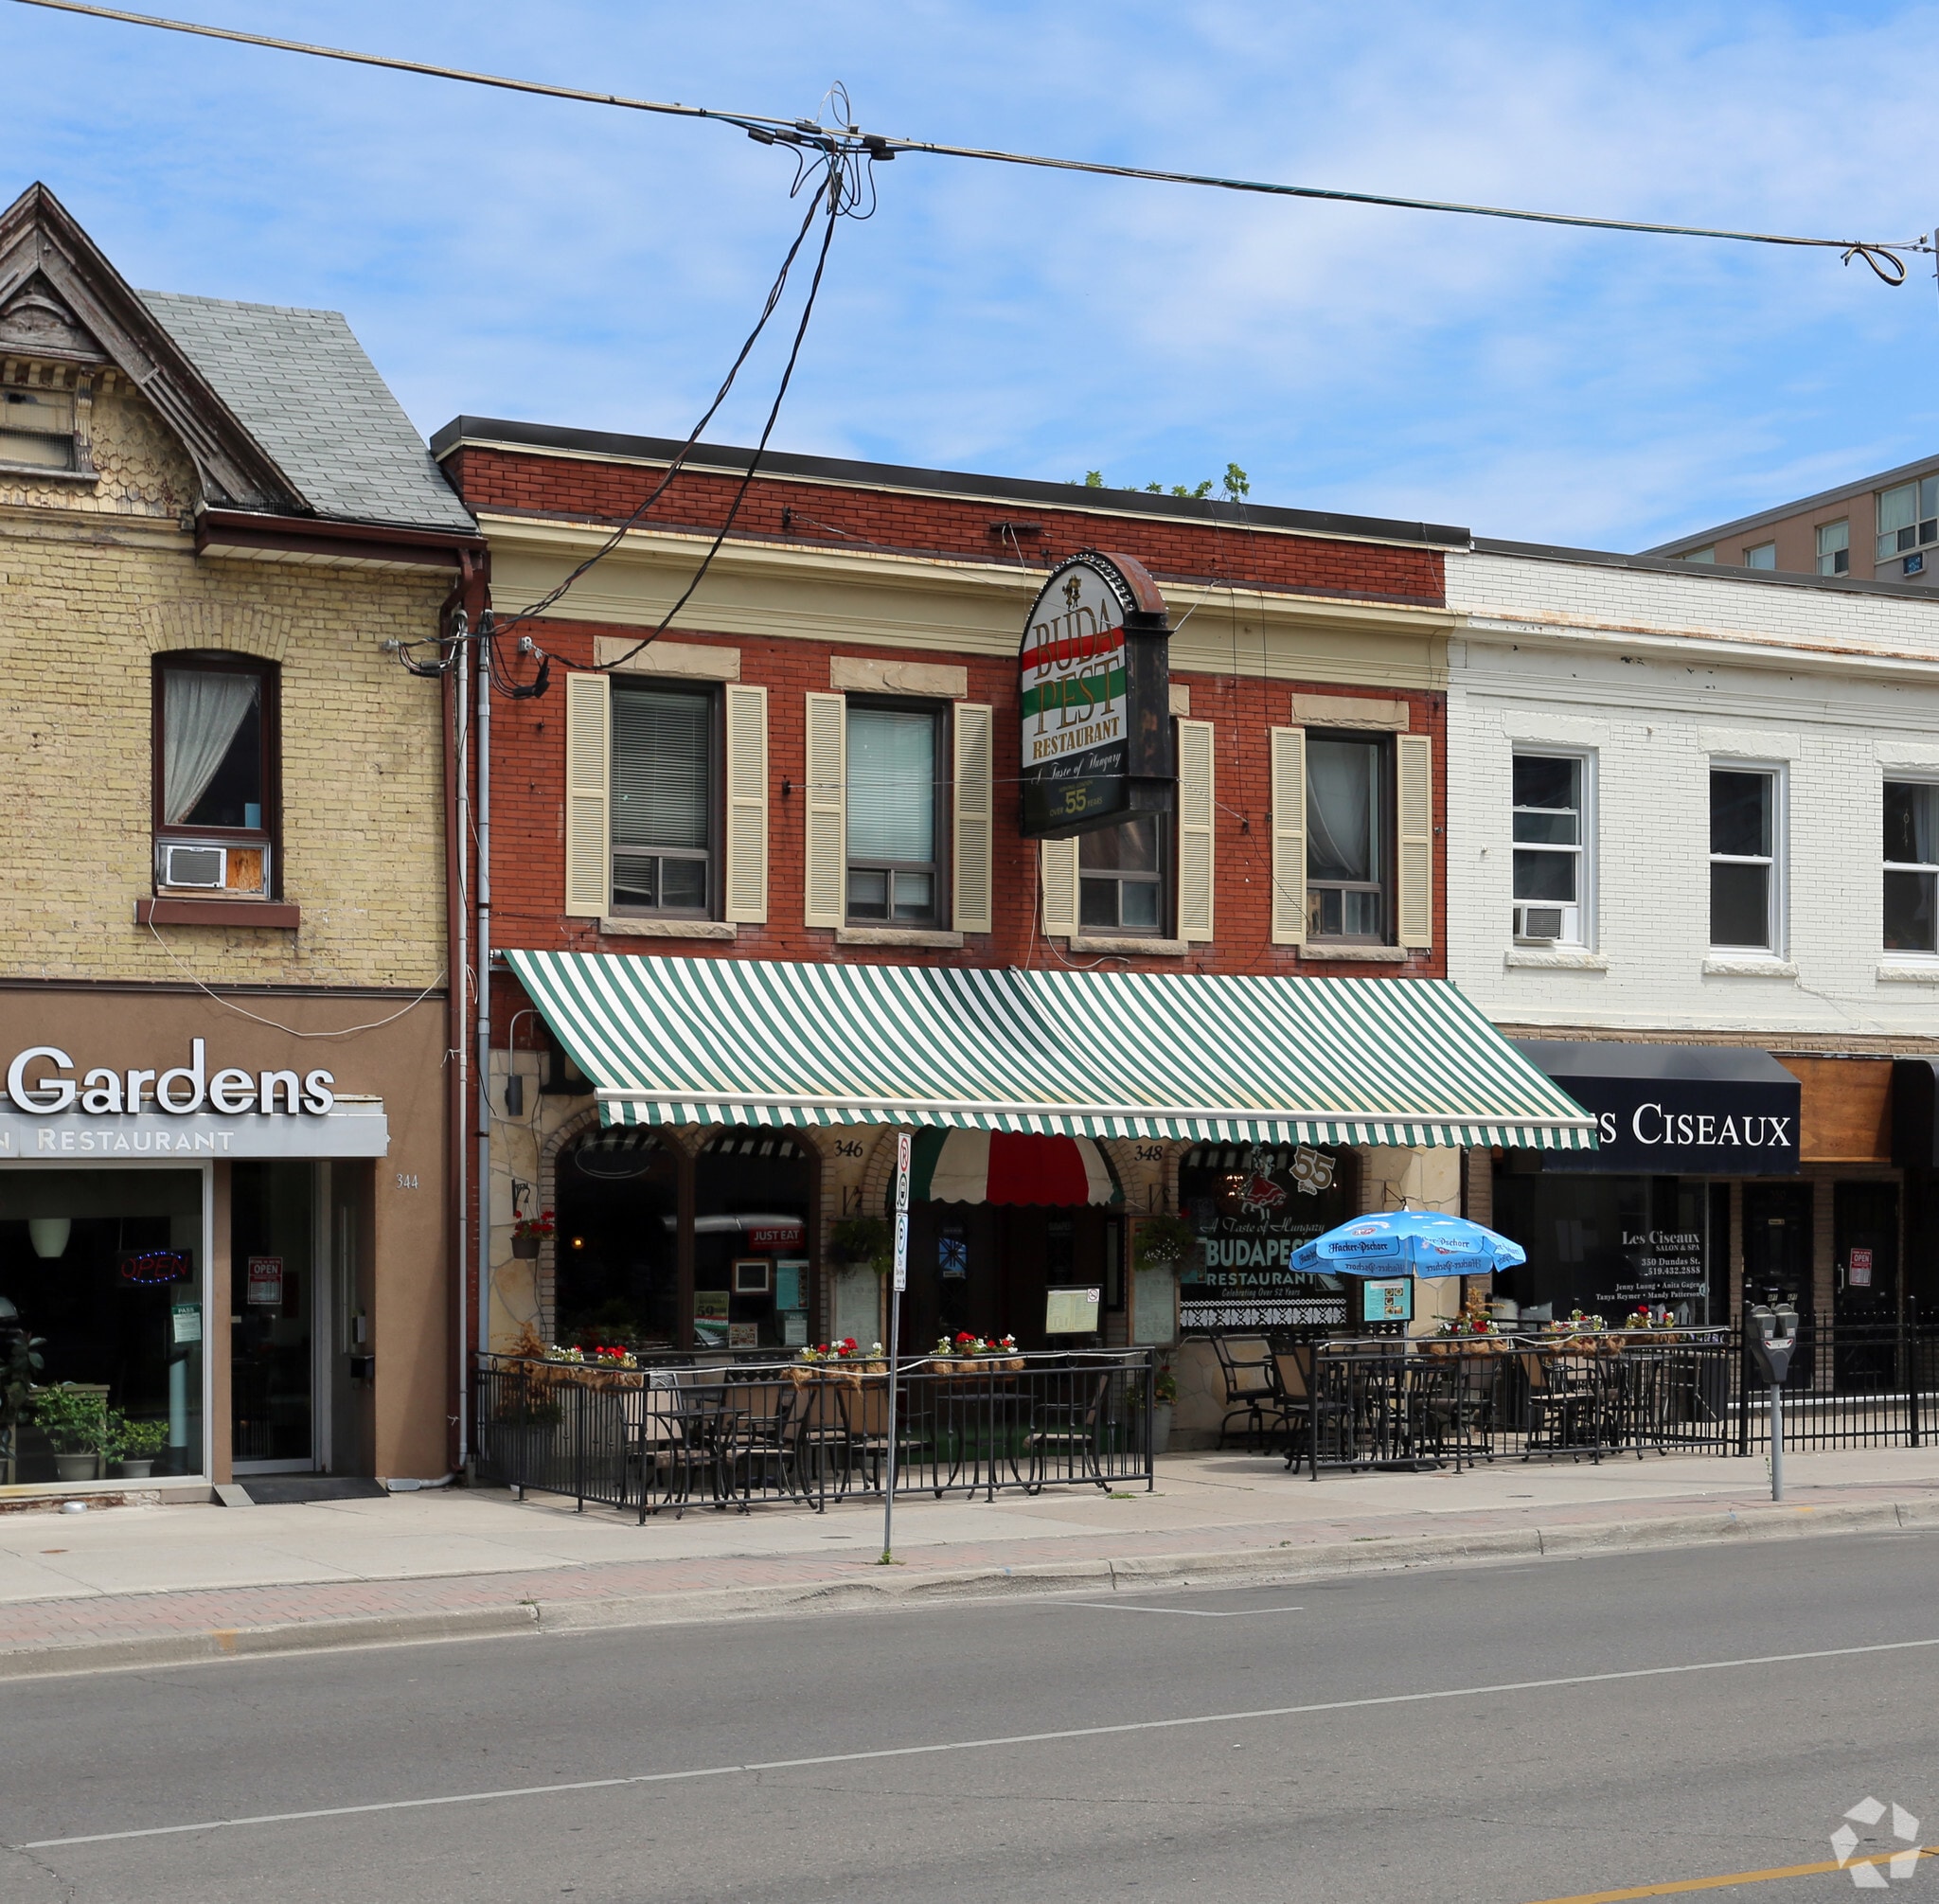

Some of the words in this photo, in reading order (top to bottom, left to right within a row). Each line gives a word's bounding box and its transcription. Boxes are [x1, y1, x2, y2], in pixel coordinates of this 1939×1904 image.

[1032, 598, 1118, 680] BUDA
[1033, 655, 1120, 737] PEST
[1033, 716, 1120, 760] RESTAURANT
[1051, 761, 1072, 780] Taste
[1074, 757, 1084, 779] of
[1089, 752, 1121, 773] Hungary
[1049, 807, 1063, 817] OVER
[1065, 788, 1087, 813] 55
[1087, 796, 1103, 807] YEARS
[8, 1038, 335, 1114] Gardens
[1593, 1112, 1617, 1144] S
[1632, 1103, 1791, 1147] CISEAUX
[38, 1128, 235, 1151] RESTAURANT
[834, 1139, 863, 1158] 346
[1134, 1145, 1164, 1161] 348
[1290, 1147, 1335, 1188] 55
[396, 1173, 418, 1190] 344
[754, 1231, 778, 1241] JUST
[780, 1230, 799, 1240] EAT
[1200, 1218, 1219, 1233] A
[1222, 1217, 1255, 1232] Taste
[1257, 1220, 1269, 1237] of
[1270, 1217, 1325, 1235] Hungary
[1622, 1231, 1645, 1245] Les
[1648, 1230, 1700, 1244] Ciseaux
[1207, 1238, 1314, 1267] BUDAPE
[1328, 1241, 1388, 1255] Hacker-Pschorr
[121, 1256, 189, 1278] OPEN
[1641, 1257, 1657, 1266] 350
[1659, 1256, 1688, 1266] Dundas
[1689, 1256, 1700, 1265] St.
[1854, 1254, 1870, 1262] OPEN
[254, 1264, 278, 1274] OPEN
[1647, 1266, 1700, 1275] 519.432.2888
[1207, 1272, 1315, 1286] RESTAURANT
[1615, 1283, 1634, 1291] Jenny
[1636, 1282, 1656, 1290] Luong
[1681, 1281, 1700, 1290] Gagen
[1221, 1288, 1256, 1299] Celebrating
[1285, 1288, 1301, 1296] Years
[1595, 1293, 1615, 1302] Tanya
[1616, 1292, 1641, 1301] Reymer
